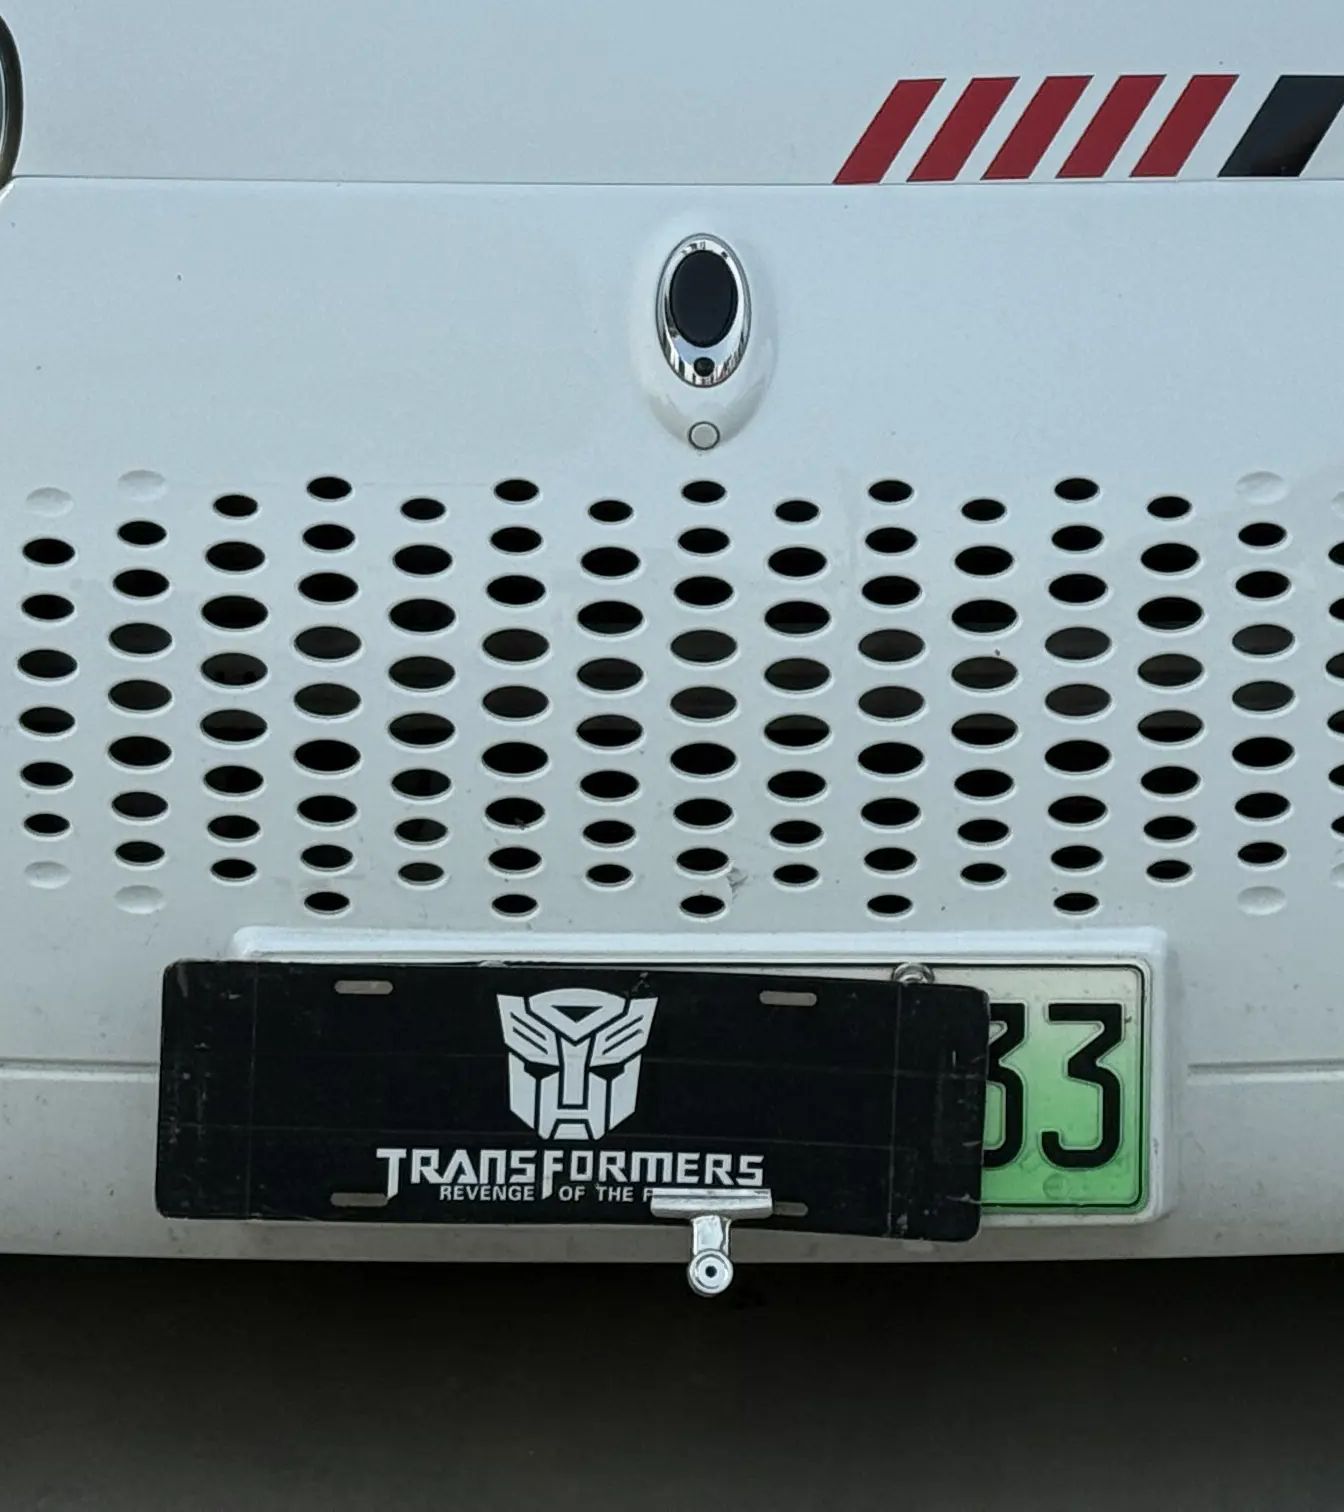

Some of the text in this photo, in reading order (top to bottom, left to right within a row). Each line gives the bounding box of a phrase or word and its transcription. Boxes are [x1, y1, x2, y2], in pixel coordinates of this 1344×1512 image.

[376, 1148, 764, 1200] TRANSFORMERS
[439, 1185, 535, 1201] REVENGE
[558, 1185, 585, 1201] OF
[595, 1184, 634, 1202] THE
